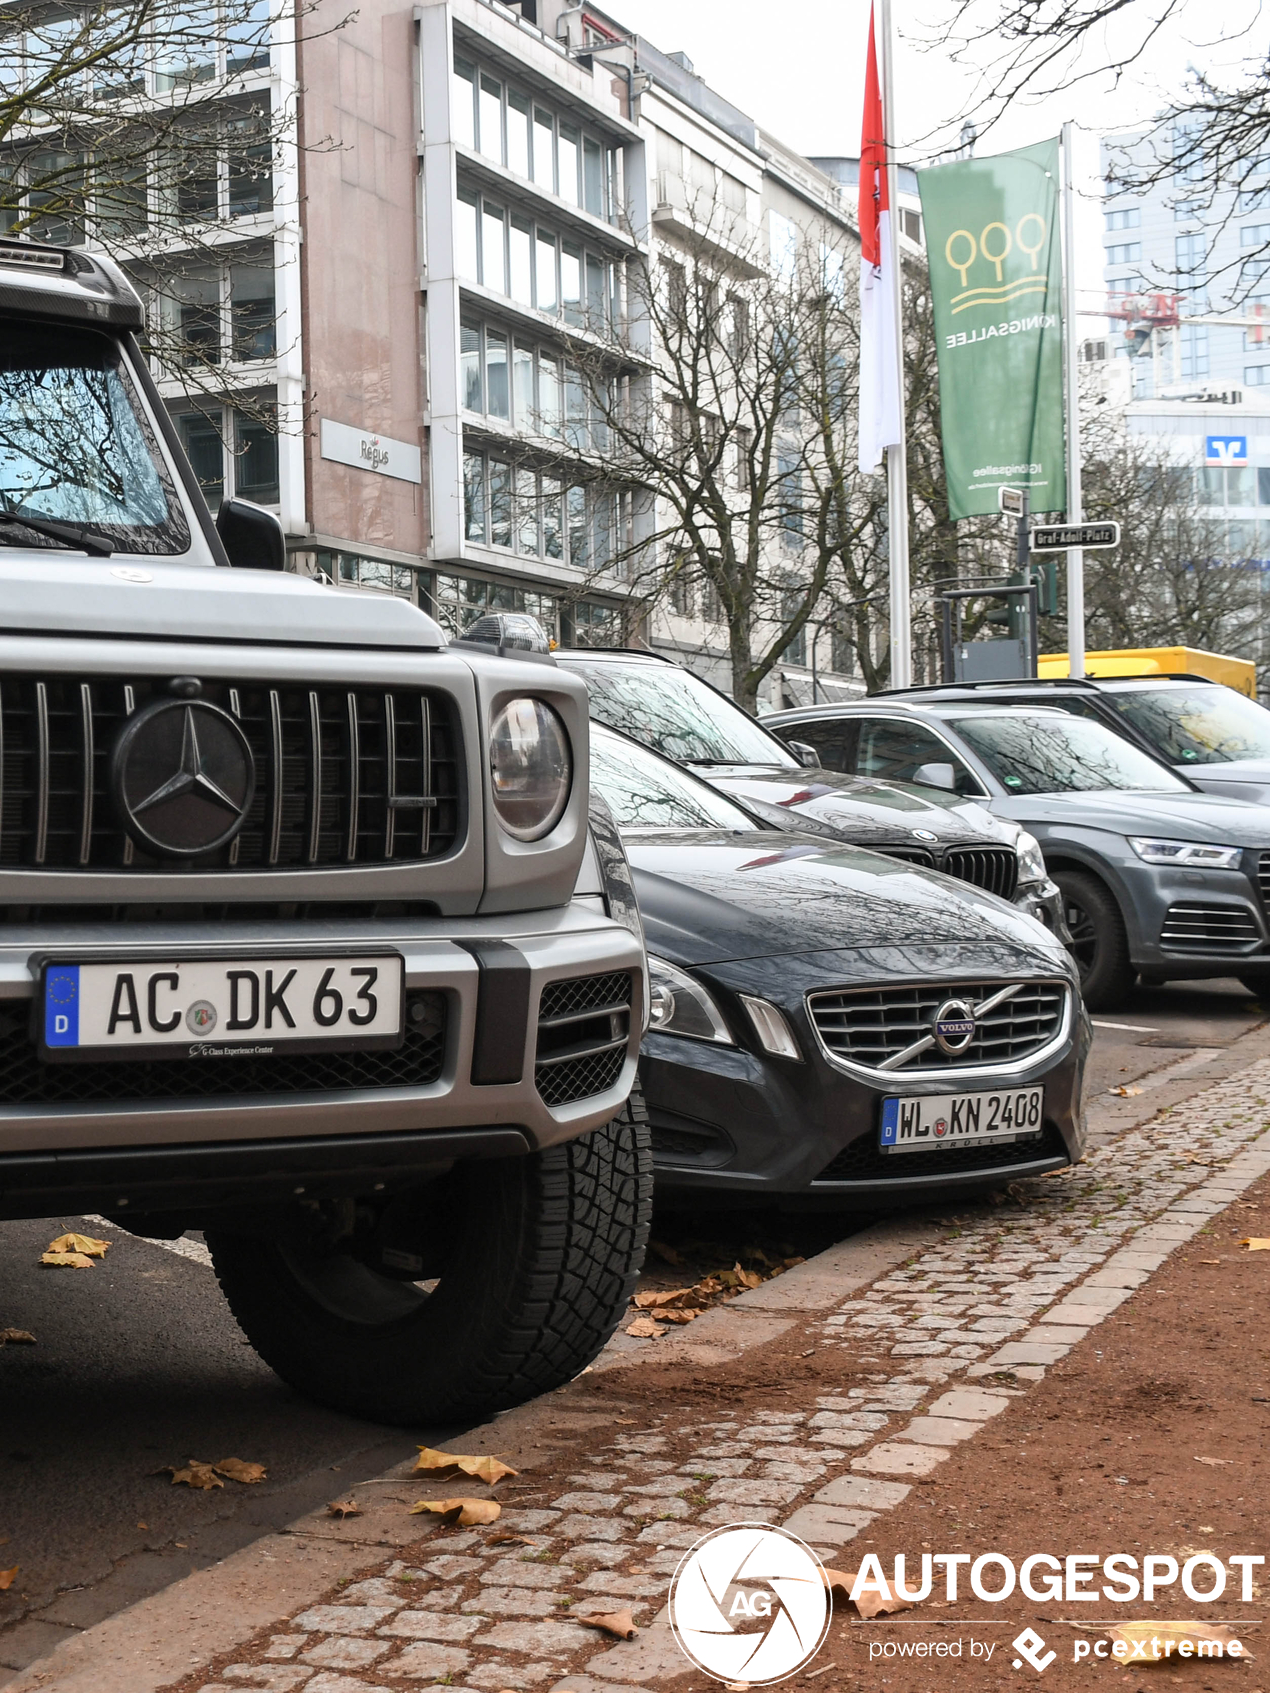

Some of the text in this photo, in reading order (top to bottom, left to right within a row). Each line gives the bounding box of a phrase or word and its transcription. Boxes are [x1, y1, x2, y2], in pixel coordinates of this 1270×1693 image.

[360, 440, 389, 469] Regus
[1038, 529, 1110, 544] Graf-Adolf-Platz
[106, 966, 378, 1034] AC DK 63
[54, 1015, 69, 1034] D
[939, 1022, 974, 1033] VOLVO
[224, 1046, 254, 1056] Experience
[255, 1046, 273, 1054] Center
[900, 1091, 1040, 1139] WL KN 2408
[885, 1126, 892, 1137] D
